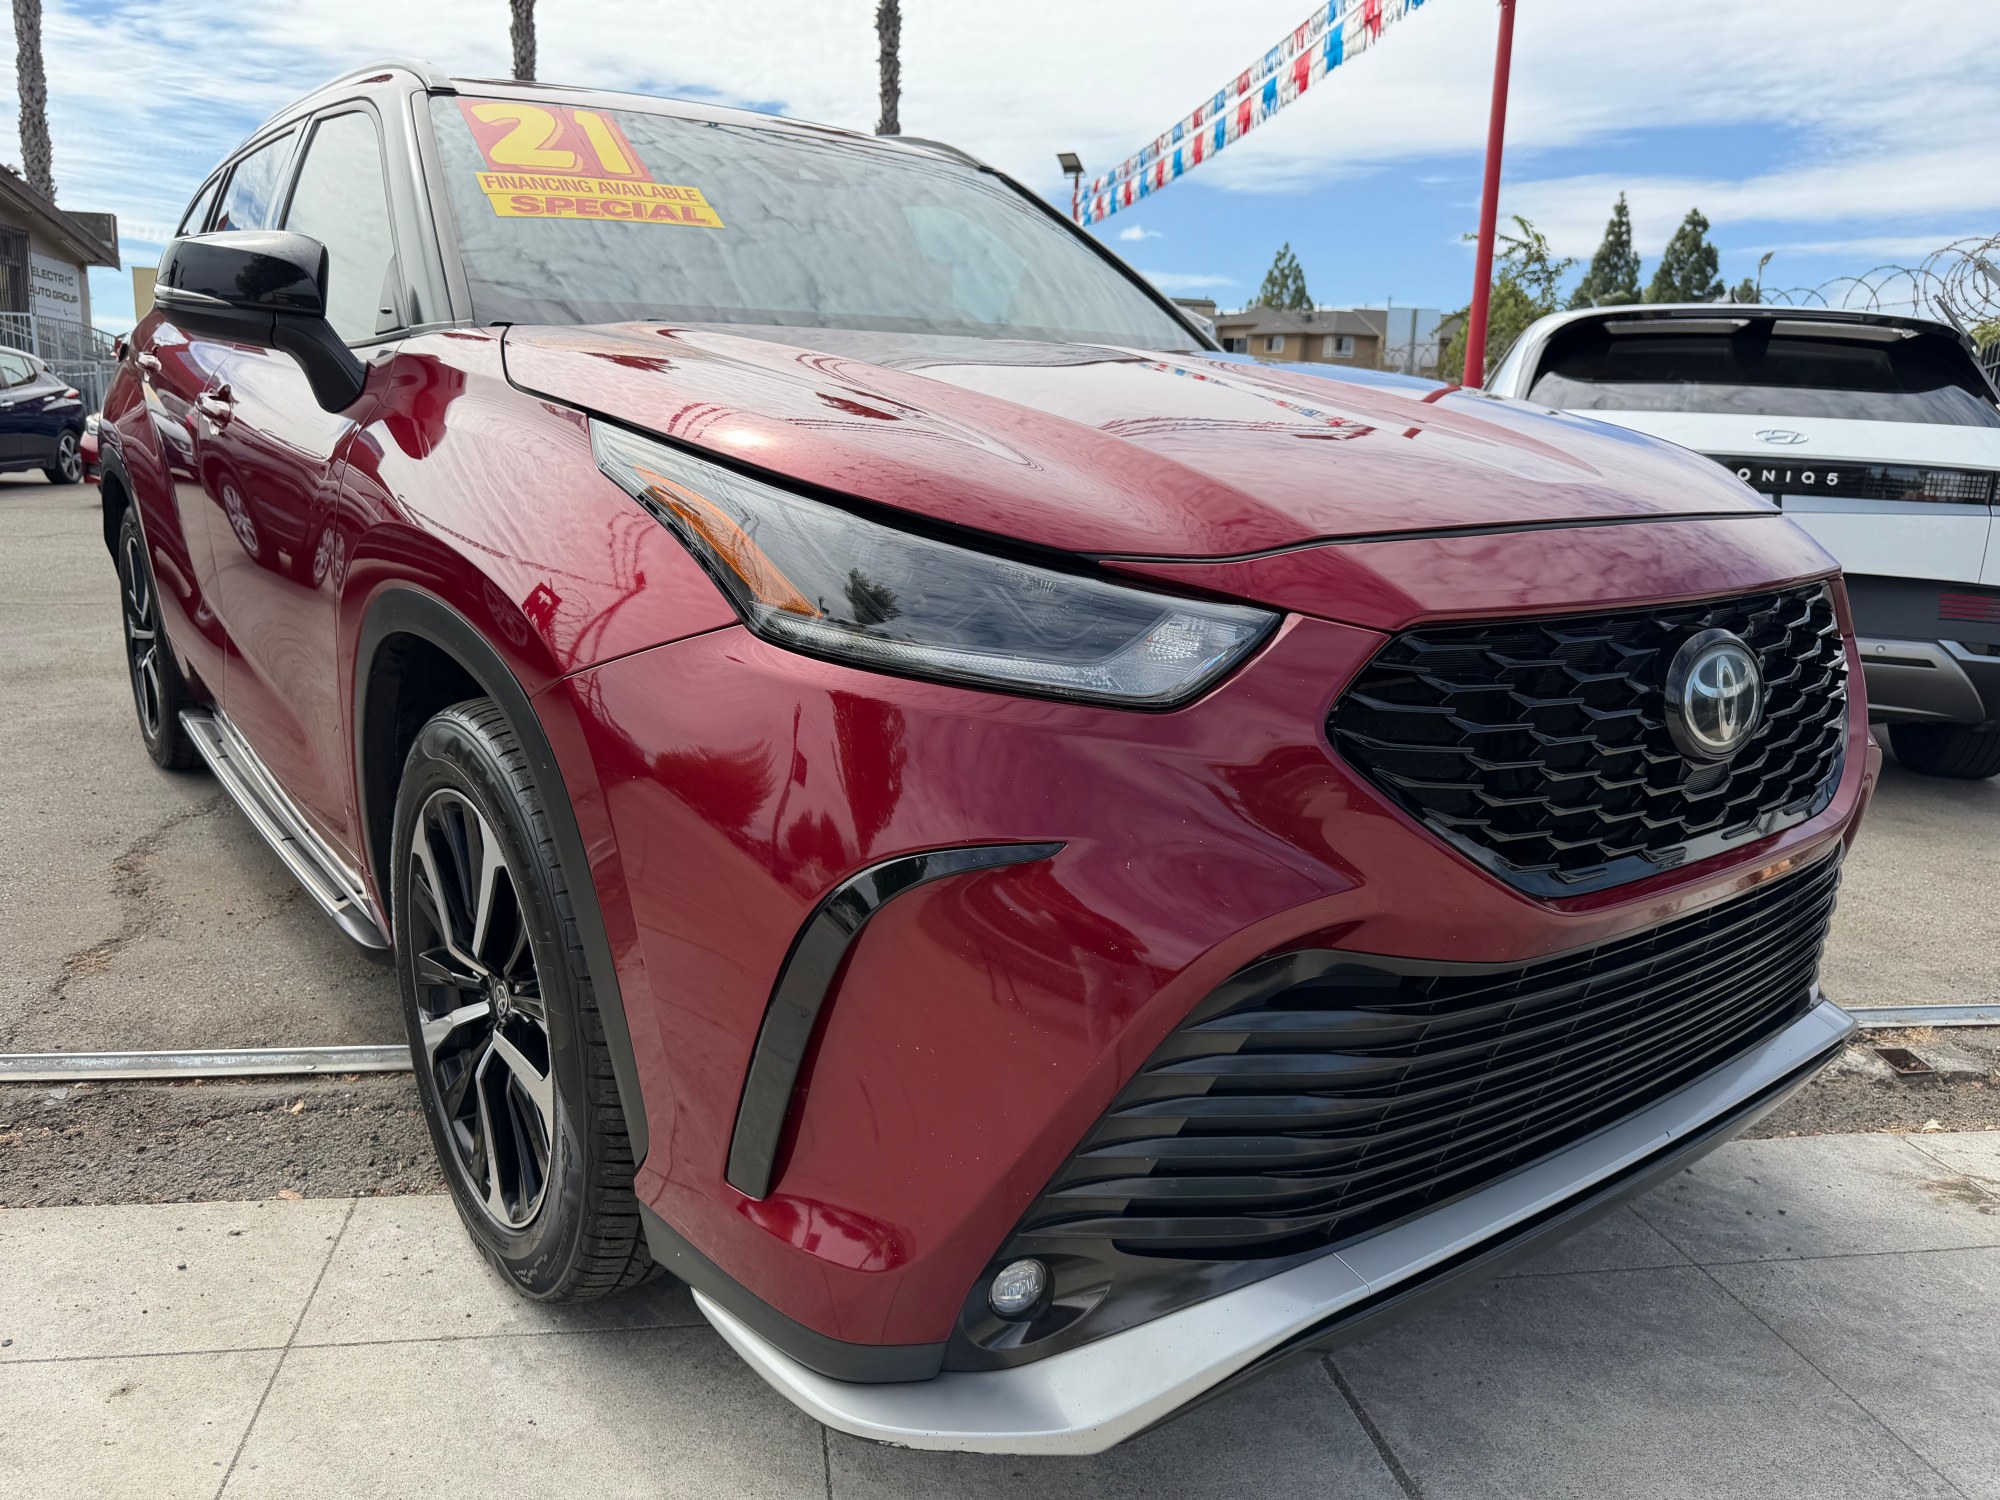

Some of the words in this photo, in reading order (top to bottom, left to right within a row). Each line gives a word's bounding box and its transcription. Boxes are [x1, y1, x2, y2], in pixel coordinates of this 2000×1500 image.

[470, 103, 642, 178] 21
[483, 175, 593, 193] FINANCING
[599, 181, 701, 202] AVAILABLE
[510, 195, 712, 225] SPECIAL
[31, 266, 74, 287] ELECTRIC
[29, 284, 51, 298] AUTO
[52, 290, 79, 303] GROUP
[1737, 467, 1815, 485] ONIQ
[1826, 472, 1839, 486] 5
